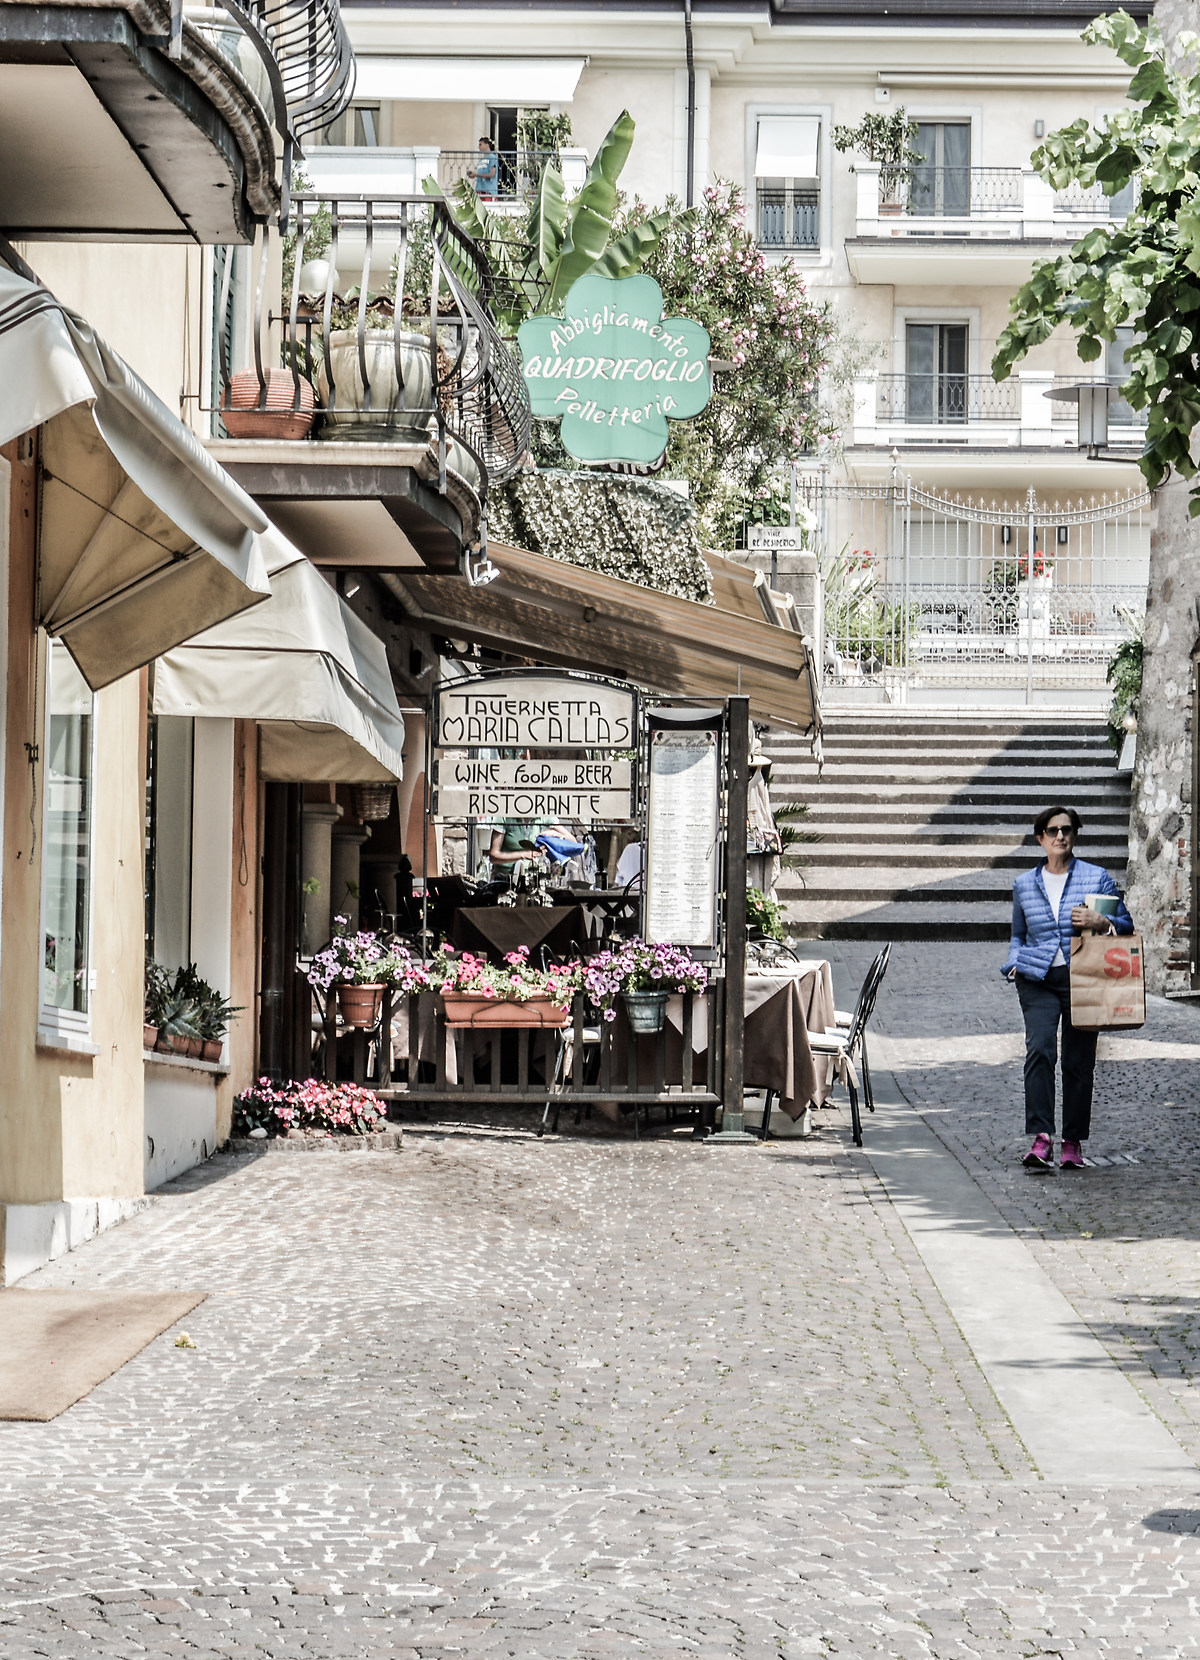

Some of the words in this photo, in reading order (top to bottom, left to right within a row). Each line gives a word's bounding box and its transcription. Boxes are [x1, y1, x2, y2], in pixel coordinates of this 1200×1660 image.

[550, 304, 689, 358] Abbigliamento
[524, 355, 705, 383] QUADRIFOGLIO
[554, 387, 678, 427] Pelletteria
[753, 539, 760, 547] RE
[449, 694, 602, 716] TAVERNETTA
[442, 716, 520, 742] MARIA
[528, 716, 630, 744] CALLAS
[574, 764, 612, 785] BEER
[468, 793, 600, 815] RISTORANTE
[1103, 947, 1140, 979] Si
